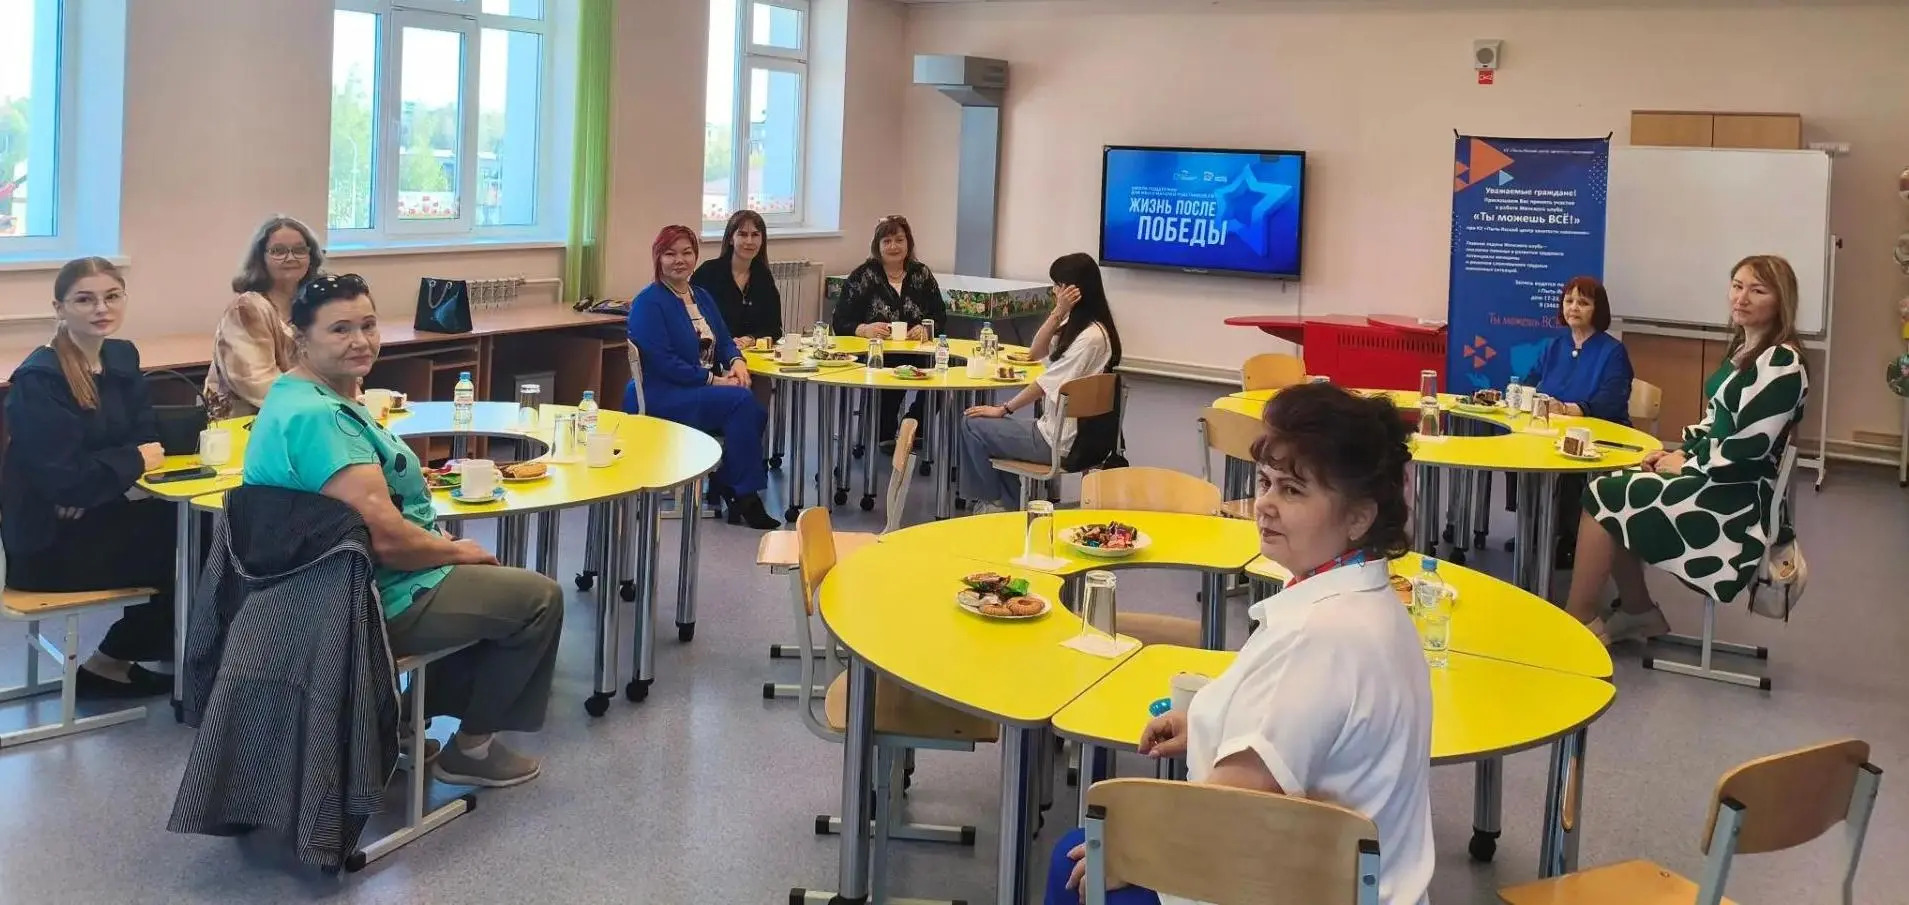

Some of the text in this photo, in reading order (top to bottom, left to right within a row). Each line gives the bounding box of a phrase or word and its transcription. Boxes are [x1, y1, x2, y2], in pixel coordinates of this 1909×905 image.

[1485, 187, 1577, 197] Уважаемые граждане!
[1129, 197, 1217, 217] ЖИЗНЬ ПОСЛЕ
[1473, 211, 1581, 225] «Ты можешь ВСЁ!»
[1137, 215, 1228, 248] ПОБЕДЫ
